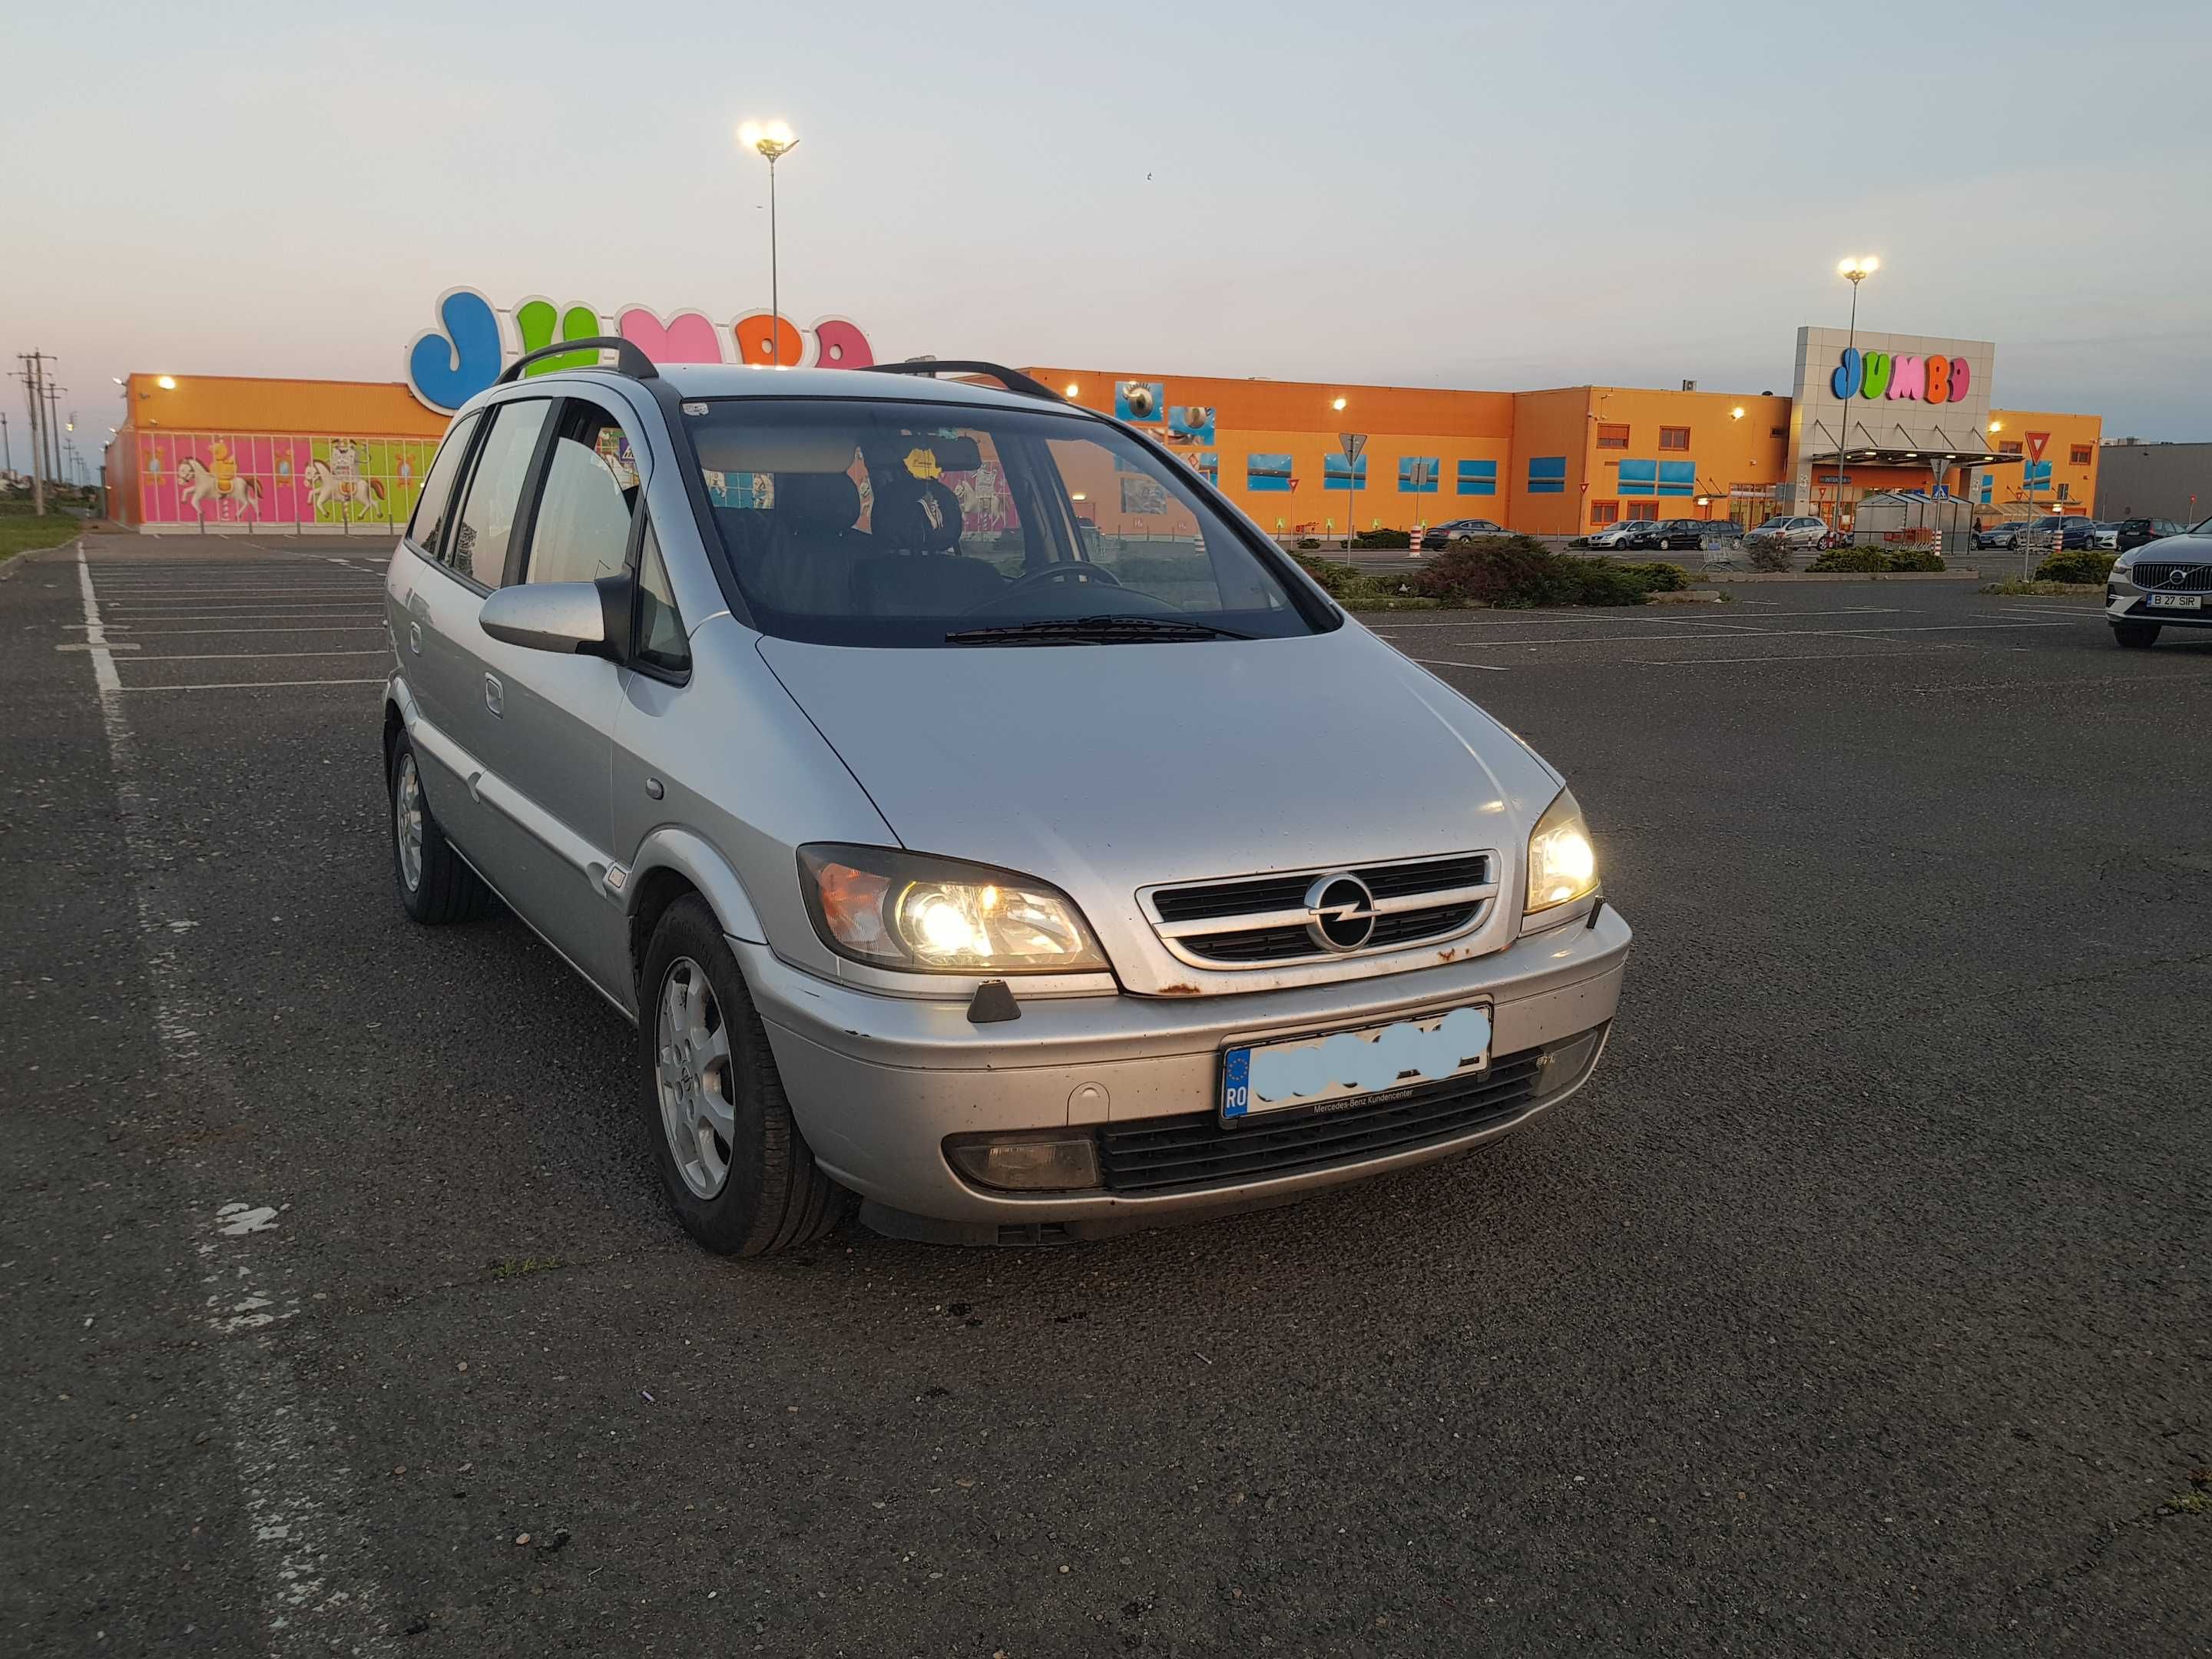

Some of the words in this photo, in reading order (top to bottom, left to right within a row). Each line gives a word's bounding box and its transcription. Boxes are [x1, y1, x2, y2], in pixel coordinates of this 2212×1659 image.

[1832, 348, 1970, 404] JUMBO
[2154, 595, 2161, 604] B
[2164, 596, 2175, 605] 27
[2179, 596, 2195, 606] SIR
[1227, 1086, 1247, 1108] RO
[1313, 1098, 1366, 1113] Mercedes-Benz
[1368, 1089, 1413, 1104] Kundencenter
